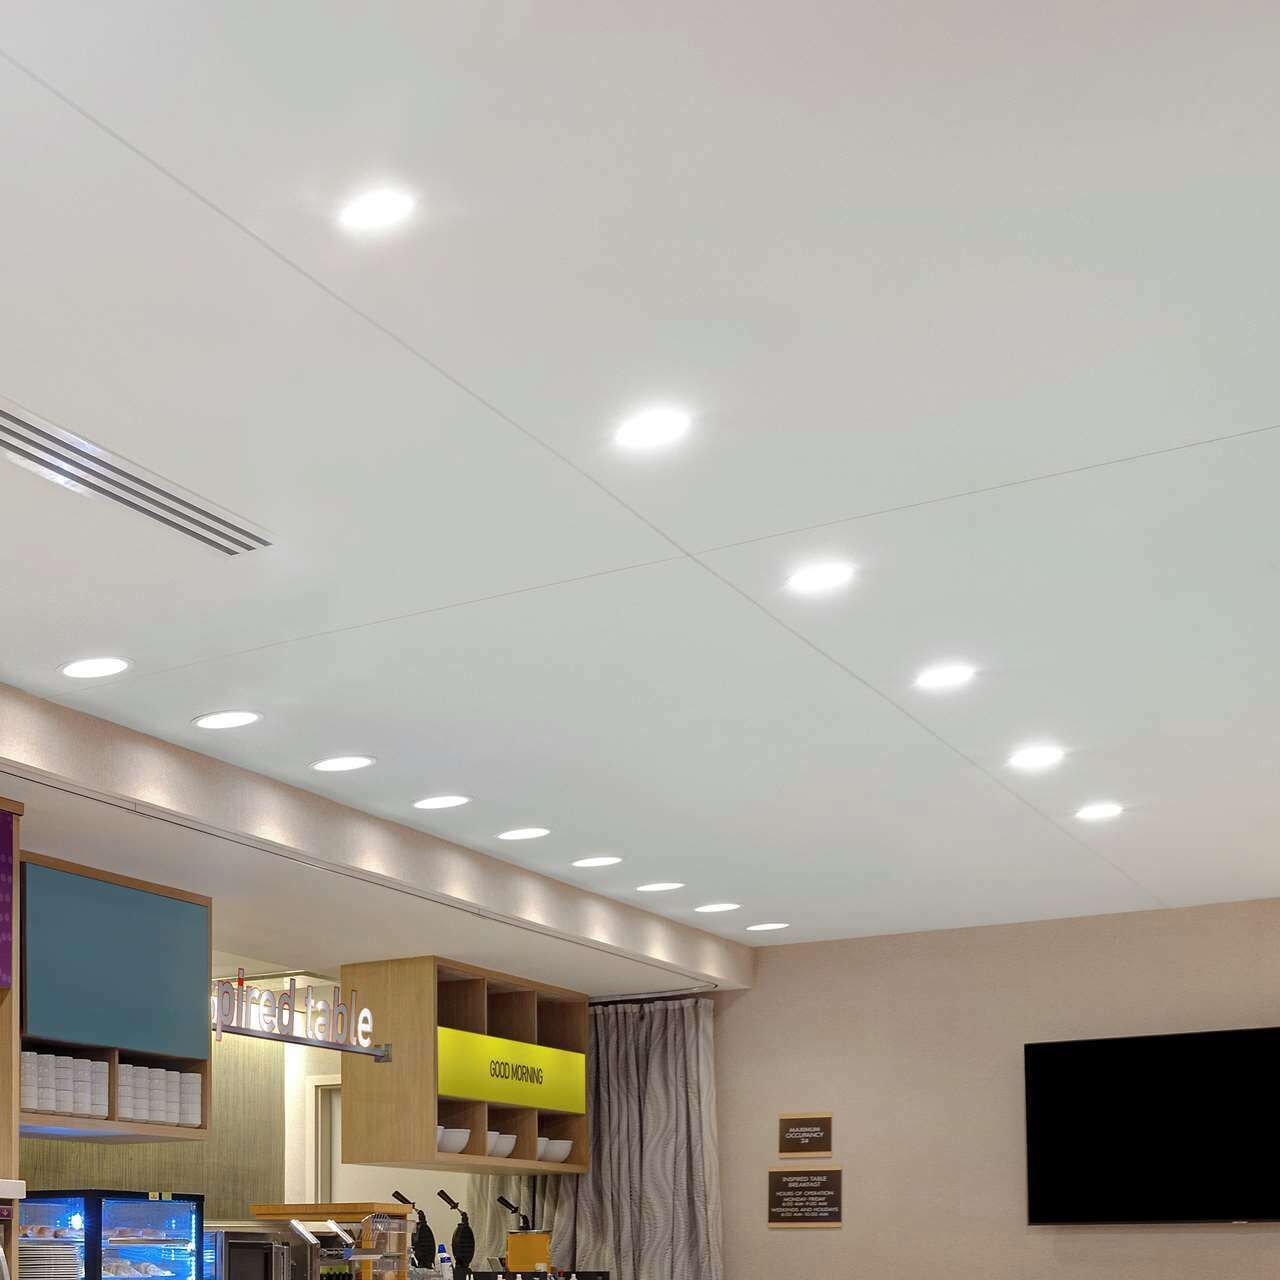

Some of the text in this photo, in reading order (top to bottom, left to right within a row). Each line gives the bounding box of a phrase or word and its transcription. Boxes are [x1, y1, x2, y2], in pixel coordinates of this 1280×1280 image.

[306, 985, 374, 1047] table
[490, 1060, 543, 1085] GOOD MORNING
